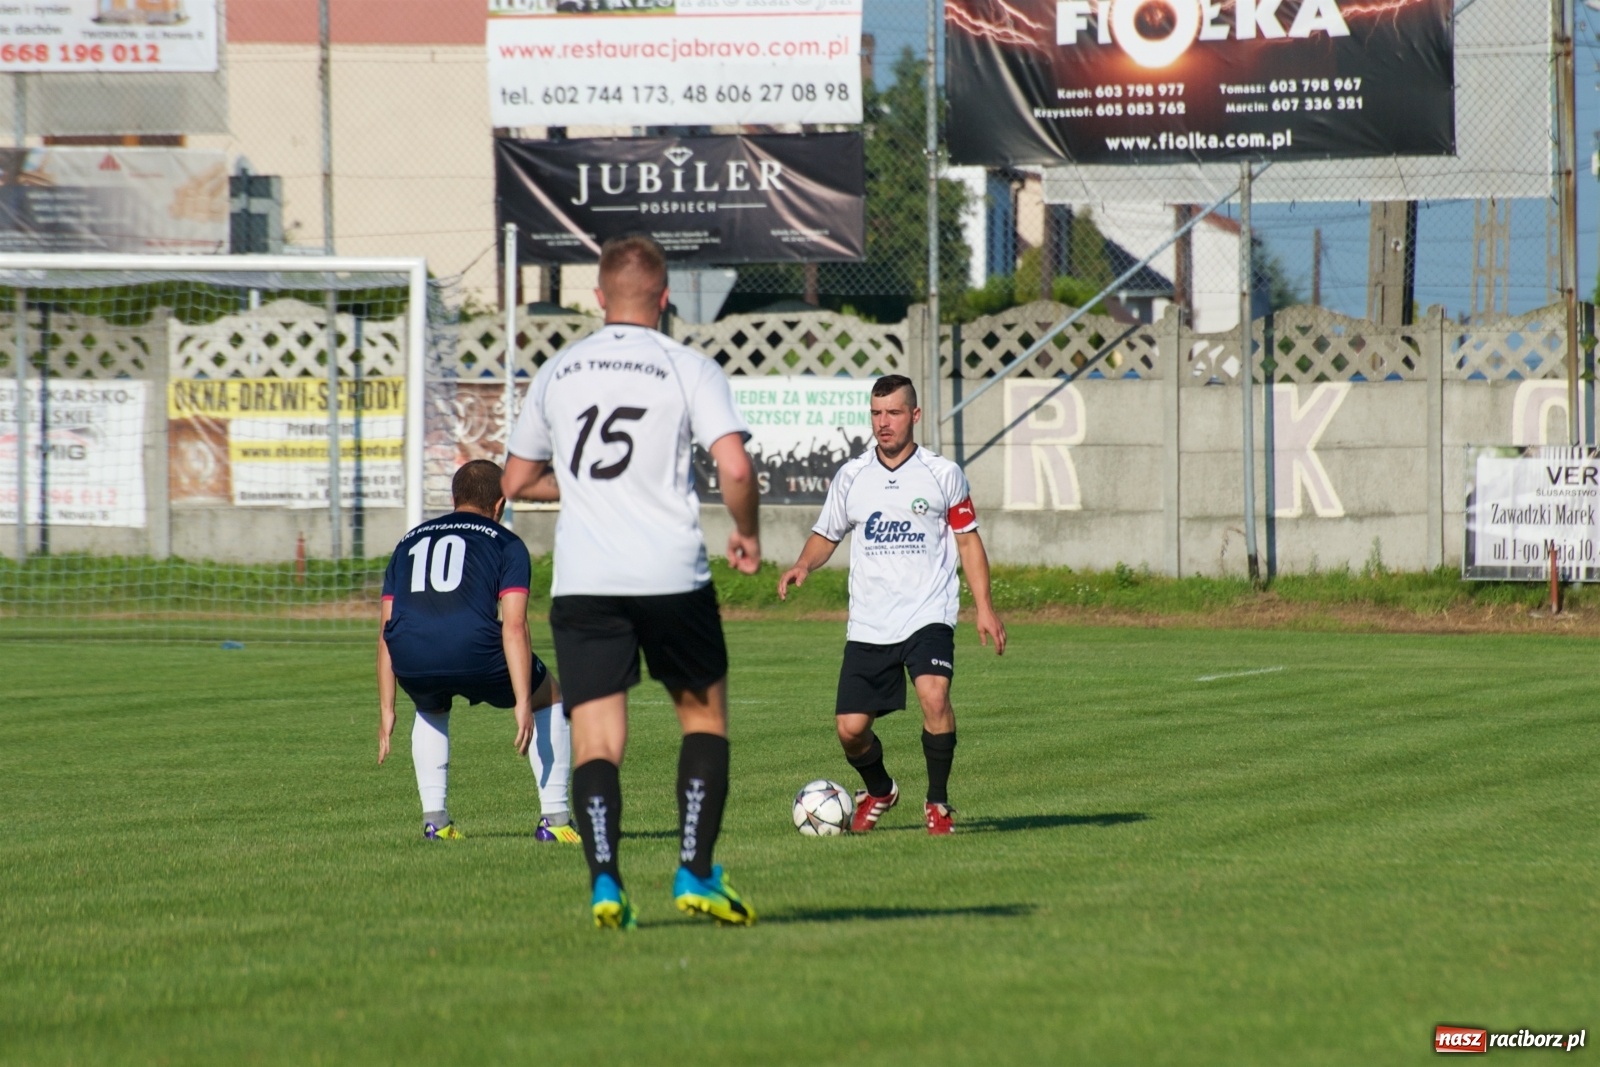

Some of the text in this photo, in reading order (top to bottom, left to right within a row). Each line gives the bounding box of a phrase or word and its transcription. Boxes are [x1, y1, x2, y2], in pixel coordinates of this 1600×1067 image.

[1, 44, 161, 63] 668 196 012
[498, 36, 850, 62] www.restauracjabravo.com.pl
[501, 83, 850, 106] tel. 602 744 173, 48 606 27 08 98
[1057, 82, 1185, 99] Karol: 603 798 977
[1220, 77, 1362, 95] Tomasz: 603 798 967
[1034, 101, 1187, 120] Krzysztof: 605 083 762
[1225, 96, 1364, 113] Marcin: 607 336 321
[1105, 129, 1292, 151] www.fiolka.com.pl
[555, 361, 582, 380] LKS
[782, 390, 801, 405] ZA
[806, 411, 824, 426] ZA
[570, 404, 648, 480] 15
[1003, 378, 1086, 511] R
[1269, 381, 1353, 518] K
[1546, 465, 1599, 486] VER
[1535, 488, 1598, 498] ŚLUSARSTWO
[1491, 503, 1596, 526] Zawadzki Marek
[416, 522, 499, 539] KRZYŻANOWICE
[865, 511, 912, 540] EURO
[874, 532, 926, 543] KANTOR
[1494, 538, 1509, 561] ul.
[1513, 538, 1540, 564] 1-go
[1543, 538, 1576, 564] Maja
[408, 534, 467, 593] 10
